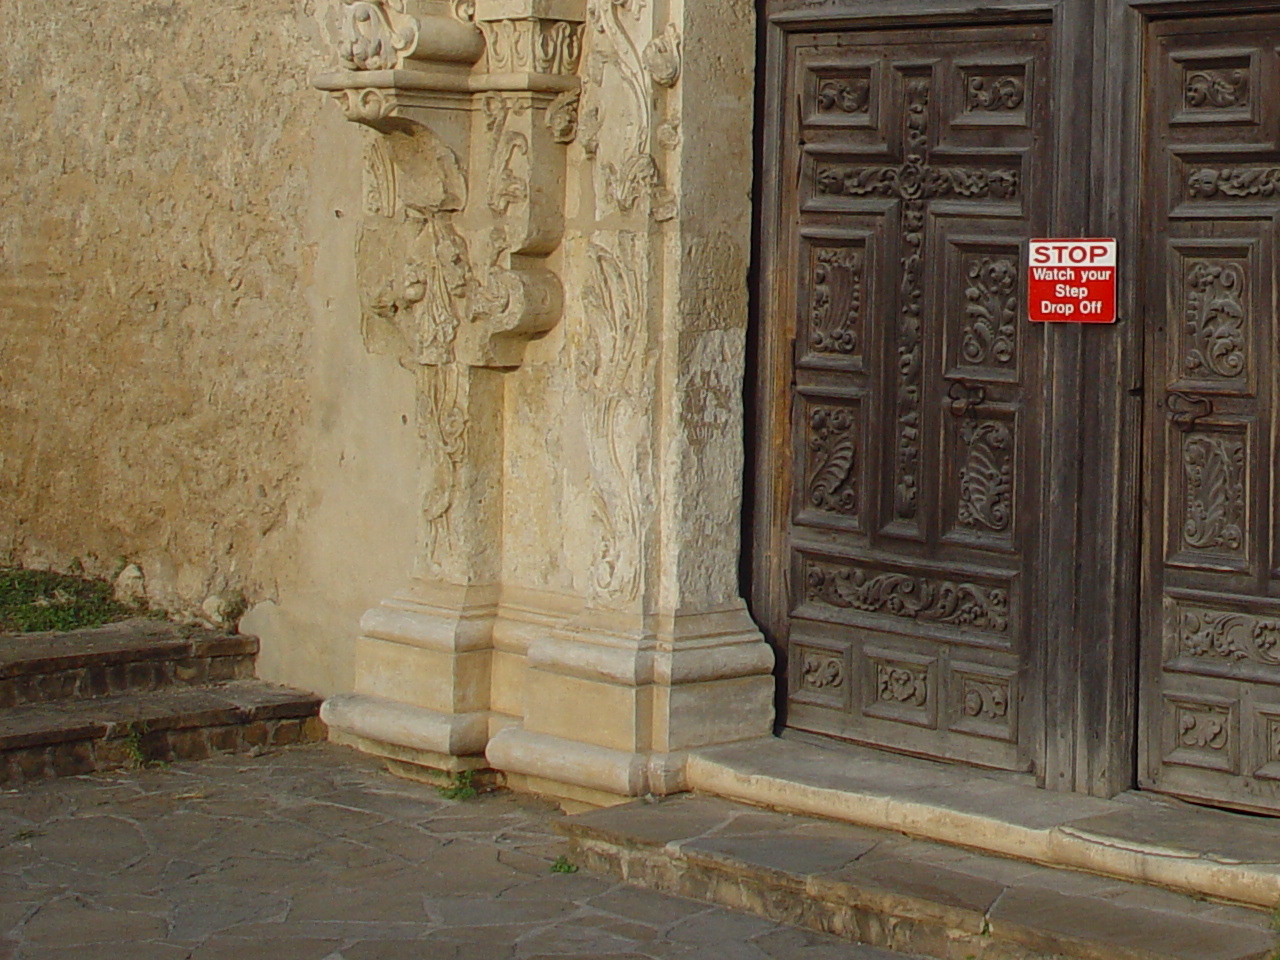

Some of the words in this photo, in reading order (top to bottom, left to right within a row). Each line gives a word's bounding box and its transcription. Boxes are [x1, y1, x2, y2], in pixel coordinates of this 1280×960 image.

[1033, 246, 1108, 263] STOP
[1033, 268, 1075, 280] Watch
[1080, 270, 1111, 283] your
[1055, 284, 1088, 299] Step
[1041, 300, 1074, 316] Drop
[1079, 300, 1102, 314] Off
